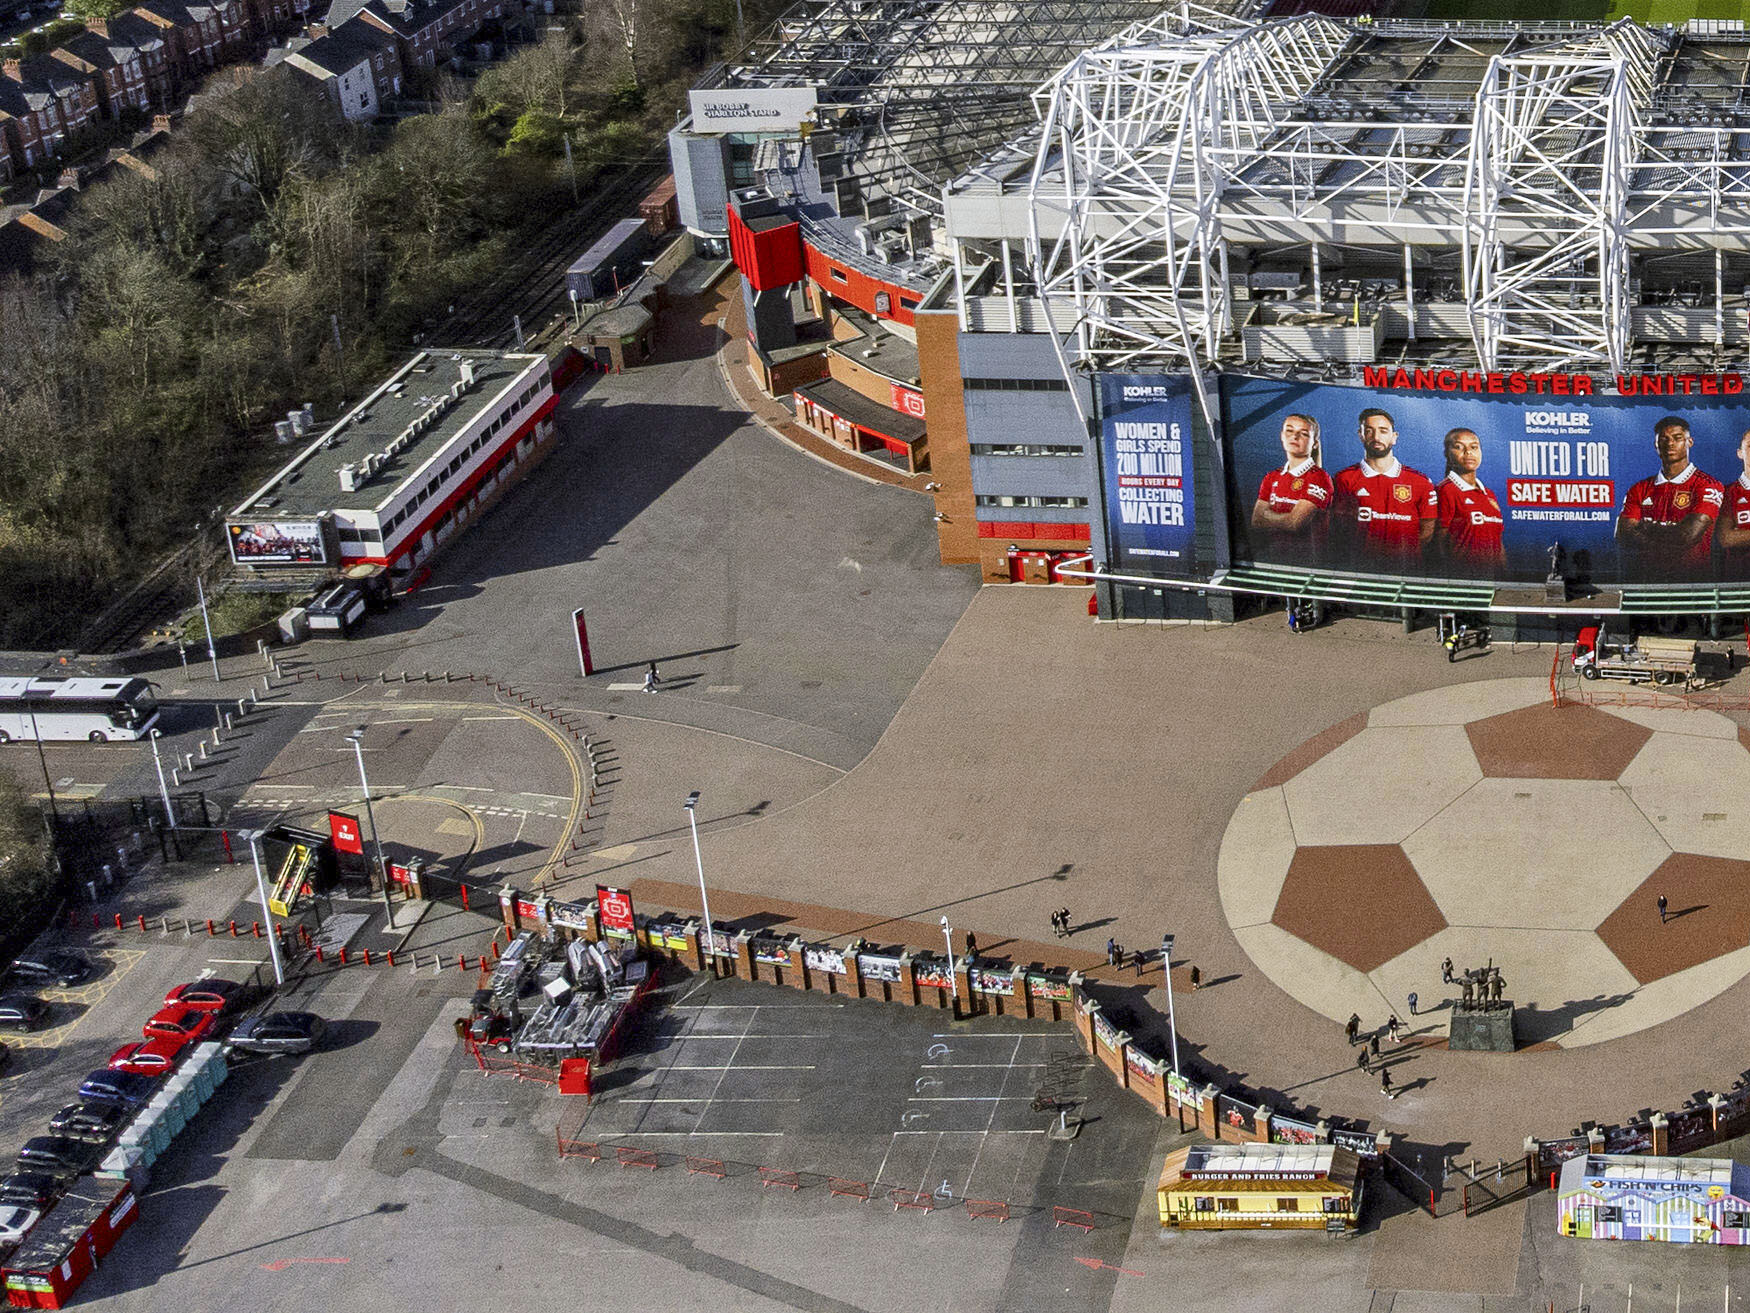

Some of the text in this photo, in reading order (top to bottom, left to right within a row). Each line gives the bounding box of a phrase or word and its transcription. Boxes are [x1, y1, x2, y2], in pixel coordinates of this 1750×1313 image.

[1363, 365, 1744, 396] MANCHESTER UNITED
[1123, 386, 1168, 397] KOHLER
[1525, 411, 1590, 426] KOHLER
[1115, 422, 1181, 440] WOMEN &
[1526, 426, 1559, 435] Believing
[1568, 427, 1591, 435] Better
[1115, 440, 1181, 453] GIRLS SPEND
[1117, 453, 1182, 477] 200 MILLION
[1509, 440, 1610, 477] UNITED FOR
[1121, 477, 1180, 487] HOURS EVERY DAY
[1119, 488, 1184, 502] COLLECTING
[1511, 482, 1610, 503] SAFE WATER
[1120, 502, 1185, 526] WATER
[1372, 510, 1412, 521] TeamViewer
[1511, 509, 1610, 521] SAFEWATERFORALL.COM
[1661, 1182, 1703, 1193] CHIPS
